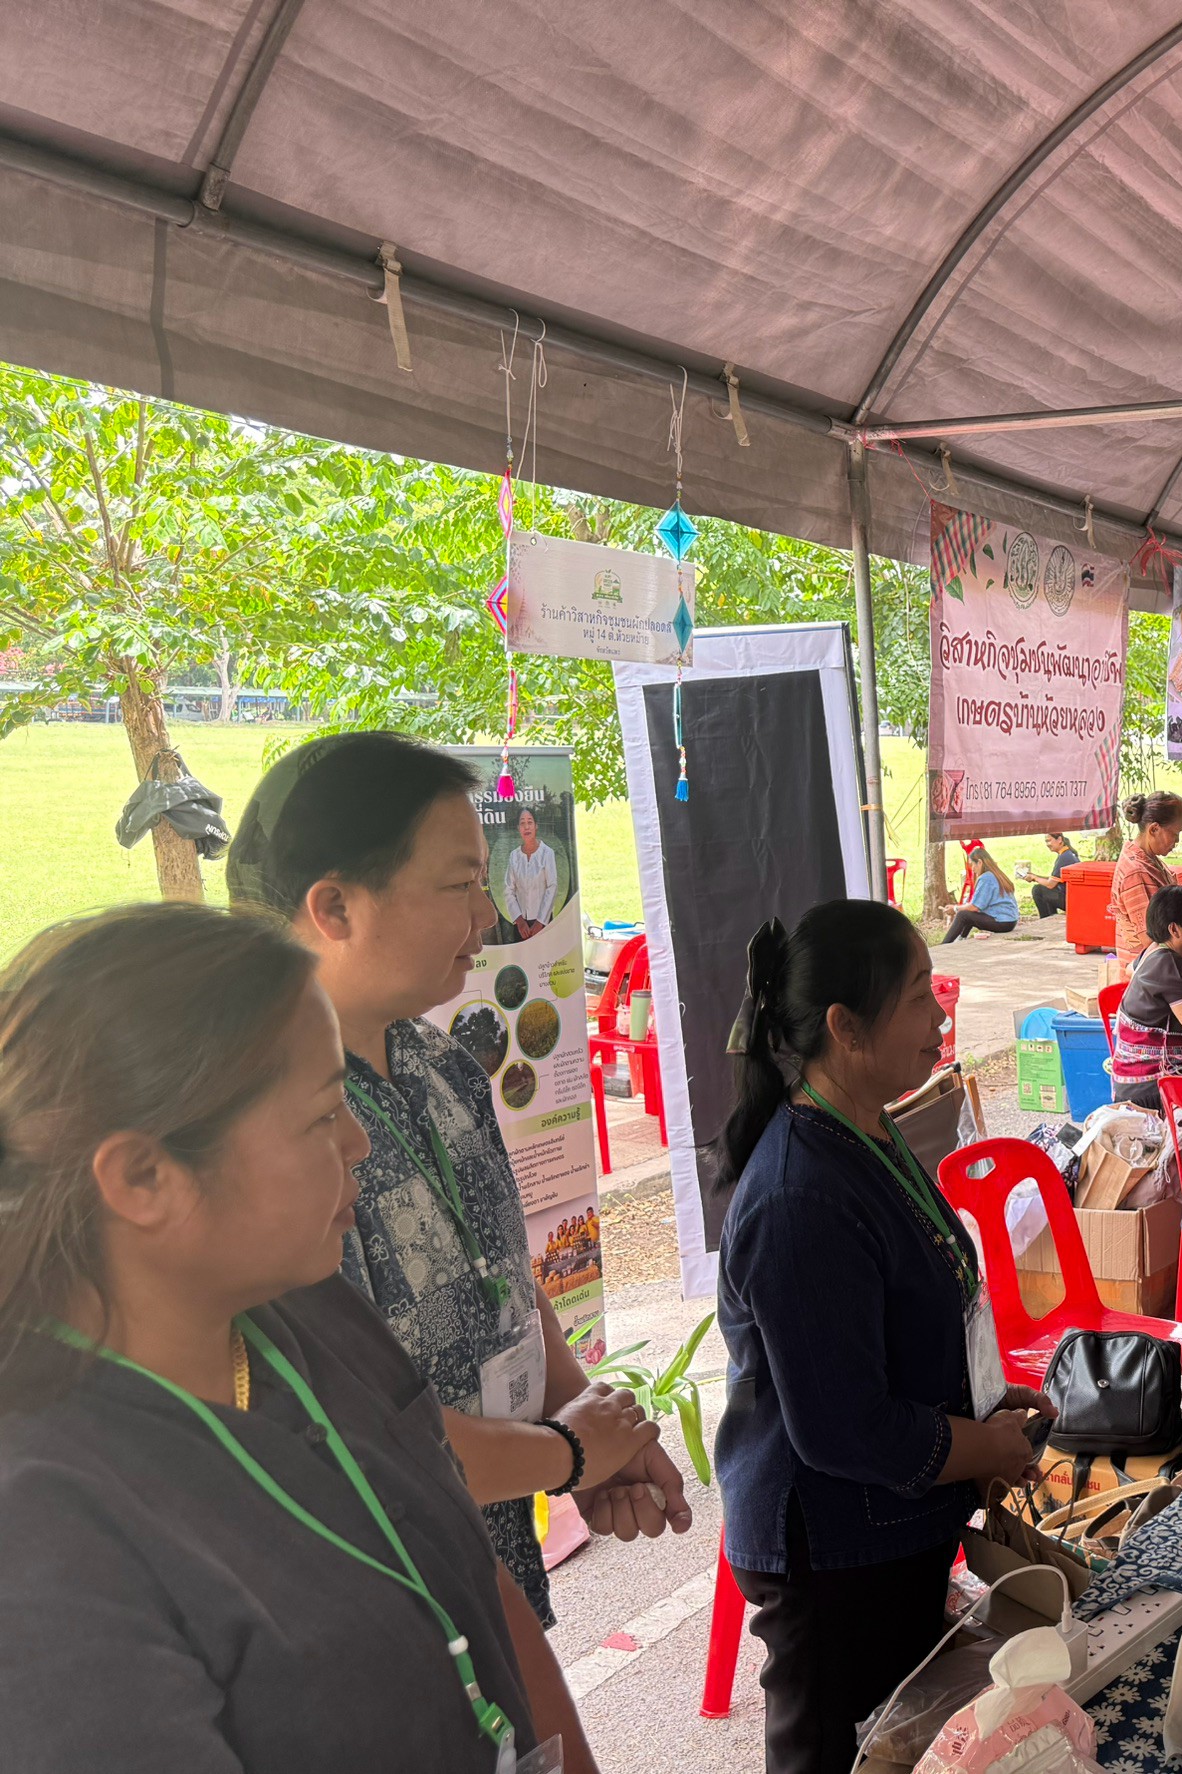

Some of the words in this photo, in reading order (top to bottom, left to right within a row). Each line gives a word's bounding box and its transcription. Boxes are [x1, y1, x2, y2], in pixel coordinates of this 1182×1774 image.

[583, 627, 595, 643] หมู่
[597, 629, 606, 639] 14
[957, 691, 1105, 740] เกษตรบ้านห้วยหลวง
[996, 781, 1012, 799] 764
[541, 1105, 581, 1128] องค์ความรู้
